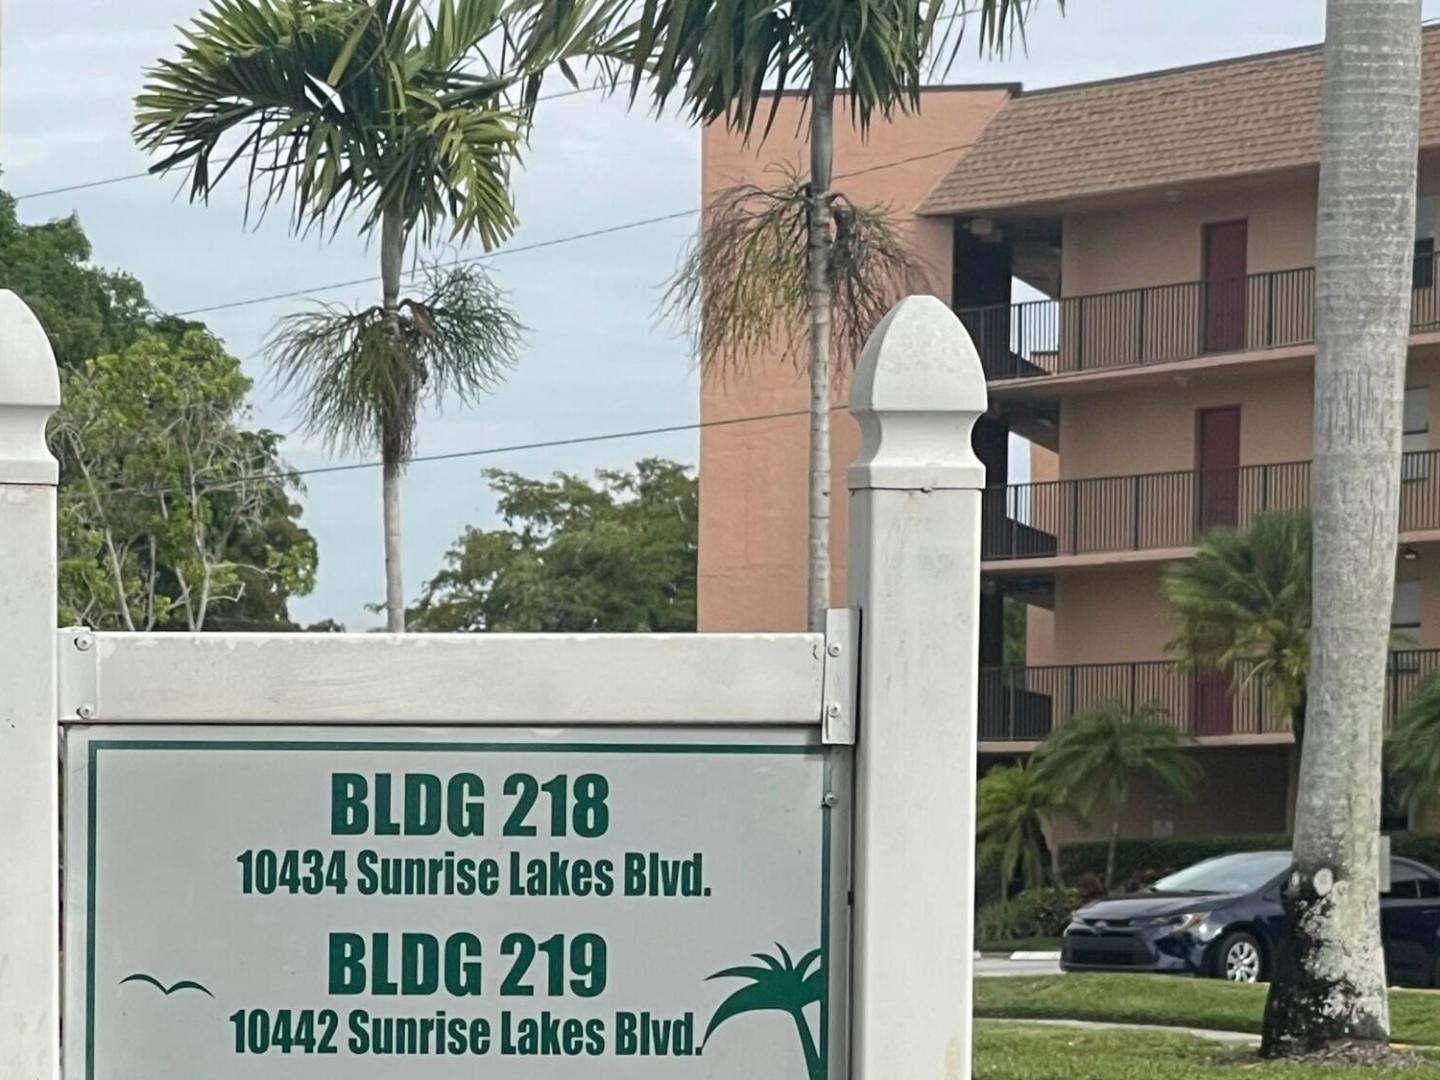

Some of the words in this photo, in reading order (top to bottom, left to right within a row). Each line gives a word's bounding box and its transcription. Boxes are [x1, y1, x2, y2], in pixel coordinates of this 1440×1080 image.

[331, 772, 485, 838] BLDG
[503, 772, 609, 838] 218
[236, 849, 348, 895] 10434
[357, 849, 500, 896] Sunrise
[509, 851, 614, 897] Lakes
[623, 852, 712, 897] Blvd.
[328, 932, 482, 997] BLDG
[499, 932, 607, 998] 219
[229, 1008, 339, 1055] 10442
[348, 1009, 491, 1056] Sunrise
[500, 1010, 605, 1056] Lakes
[615, 1011, 703, 1057] Blvd.
